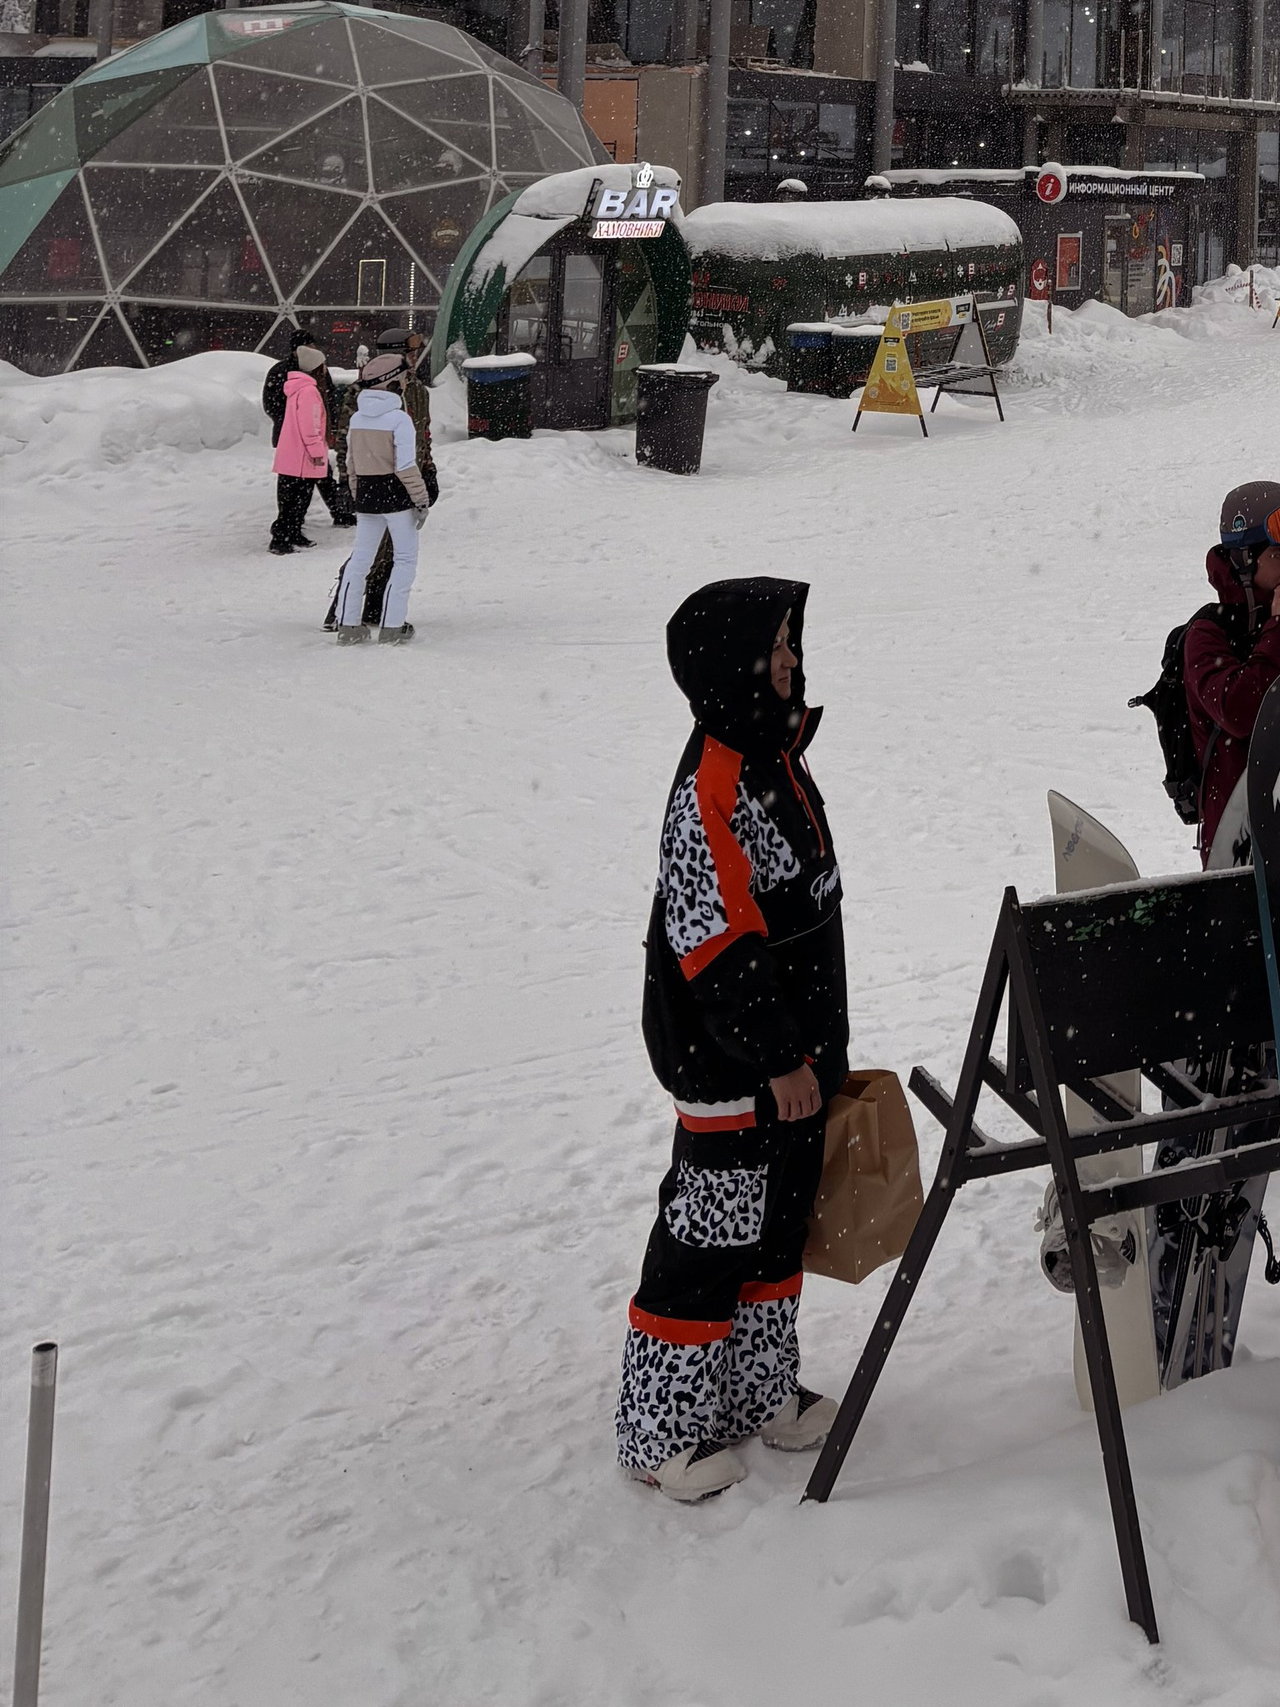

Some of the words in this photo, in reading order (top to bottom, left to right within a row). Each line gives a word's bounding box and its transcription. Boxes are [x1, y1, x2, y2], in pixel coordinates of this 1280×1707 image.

[1069, 182, 1148, 196] ИНФОРМАЦИОННЫЙ
[1150, 185, 1175, 197] ЦЕНТР
[597, 189, 678, 218] BAR
[595, 221, 664, 237] ХАМОВНИКИ
